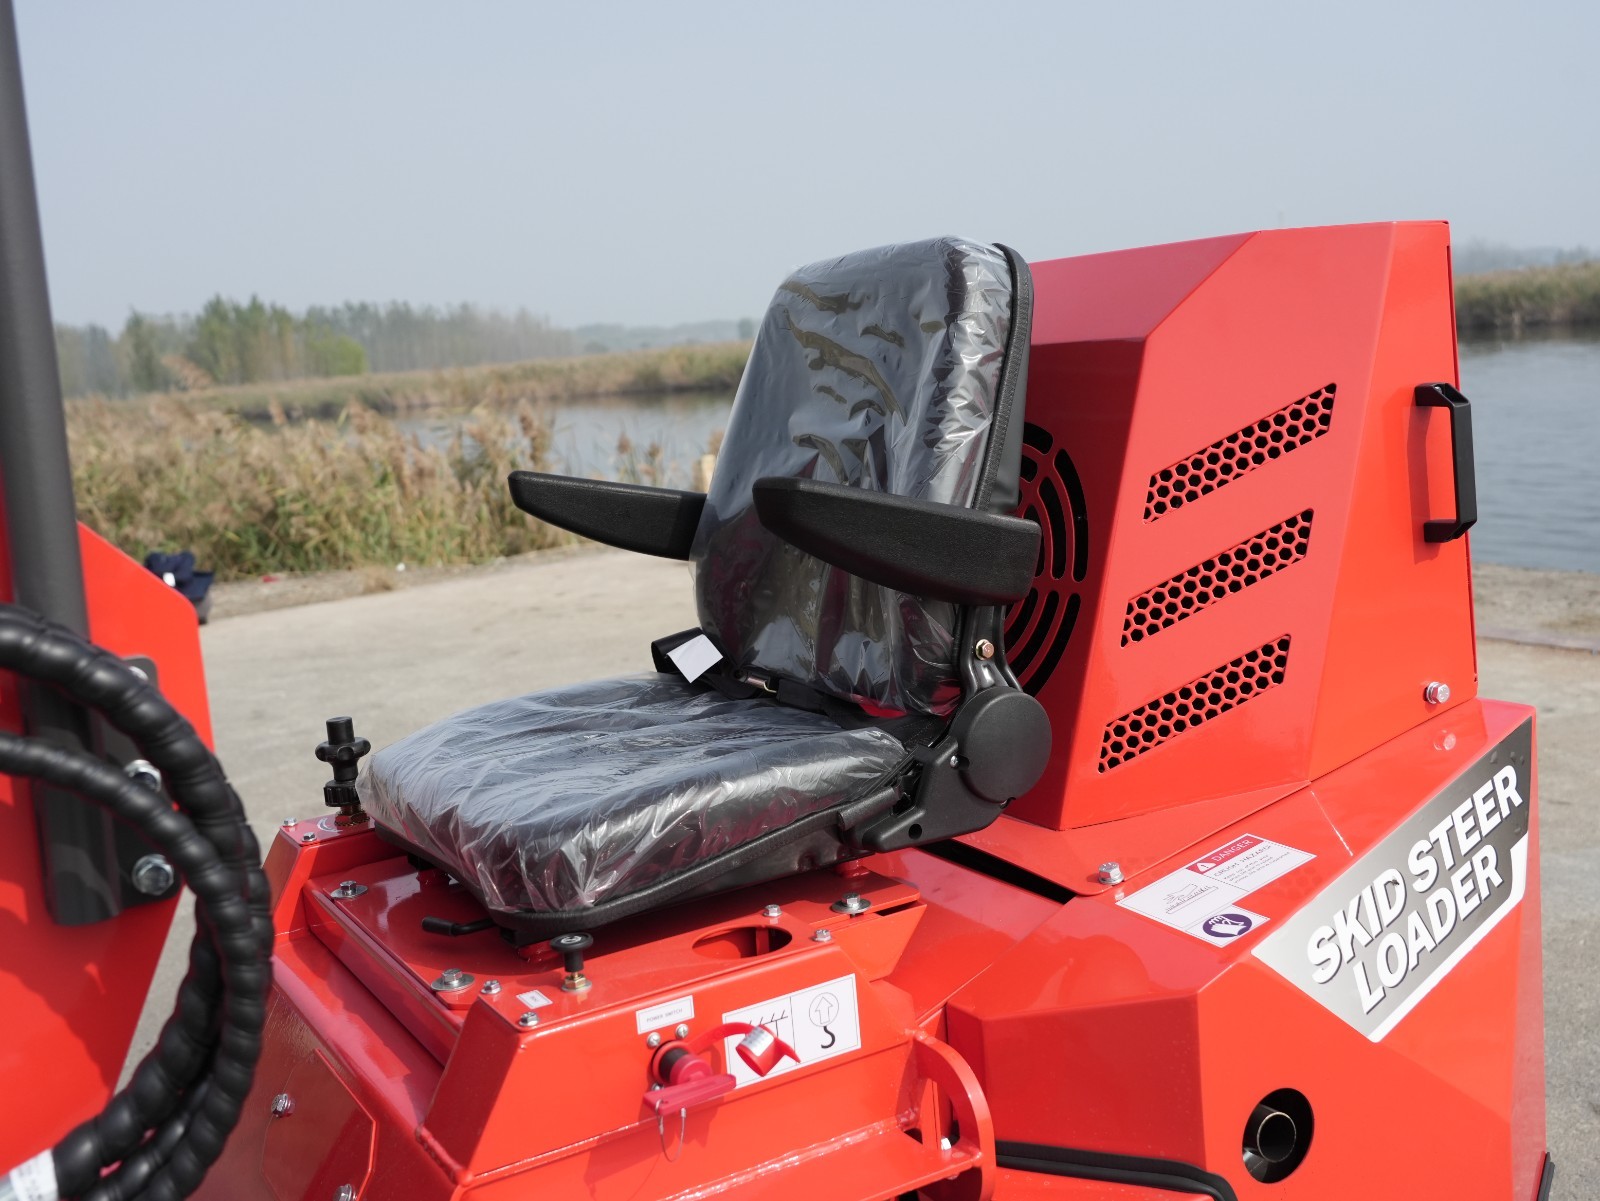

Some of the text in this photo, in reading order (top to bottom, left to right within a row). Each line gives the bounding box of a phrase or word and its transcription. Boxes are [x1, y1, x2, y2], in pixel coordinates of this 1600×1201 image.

[1211, 839, 1254, 862] DANGER
[1307, 765, 1523, 984] SKID STEER
[1353, 844, 1504, 1015] LOADER
[646, 1008, 683, 1022] POWER SWITCH
